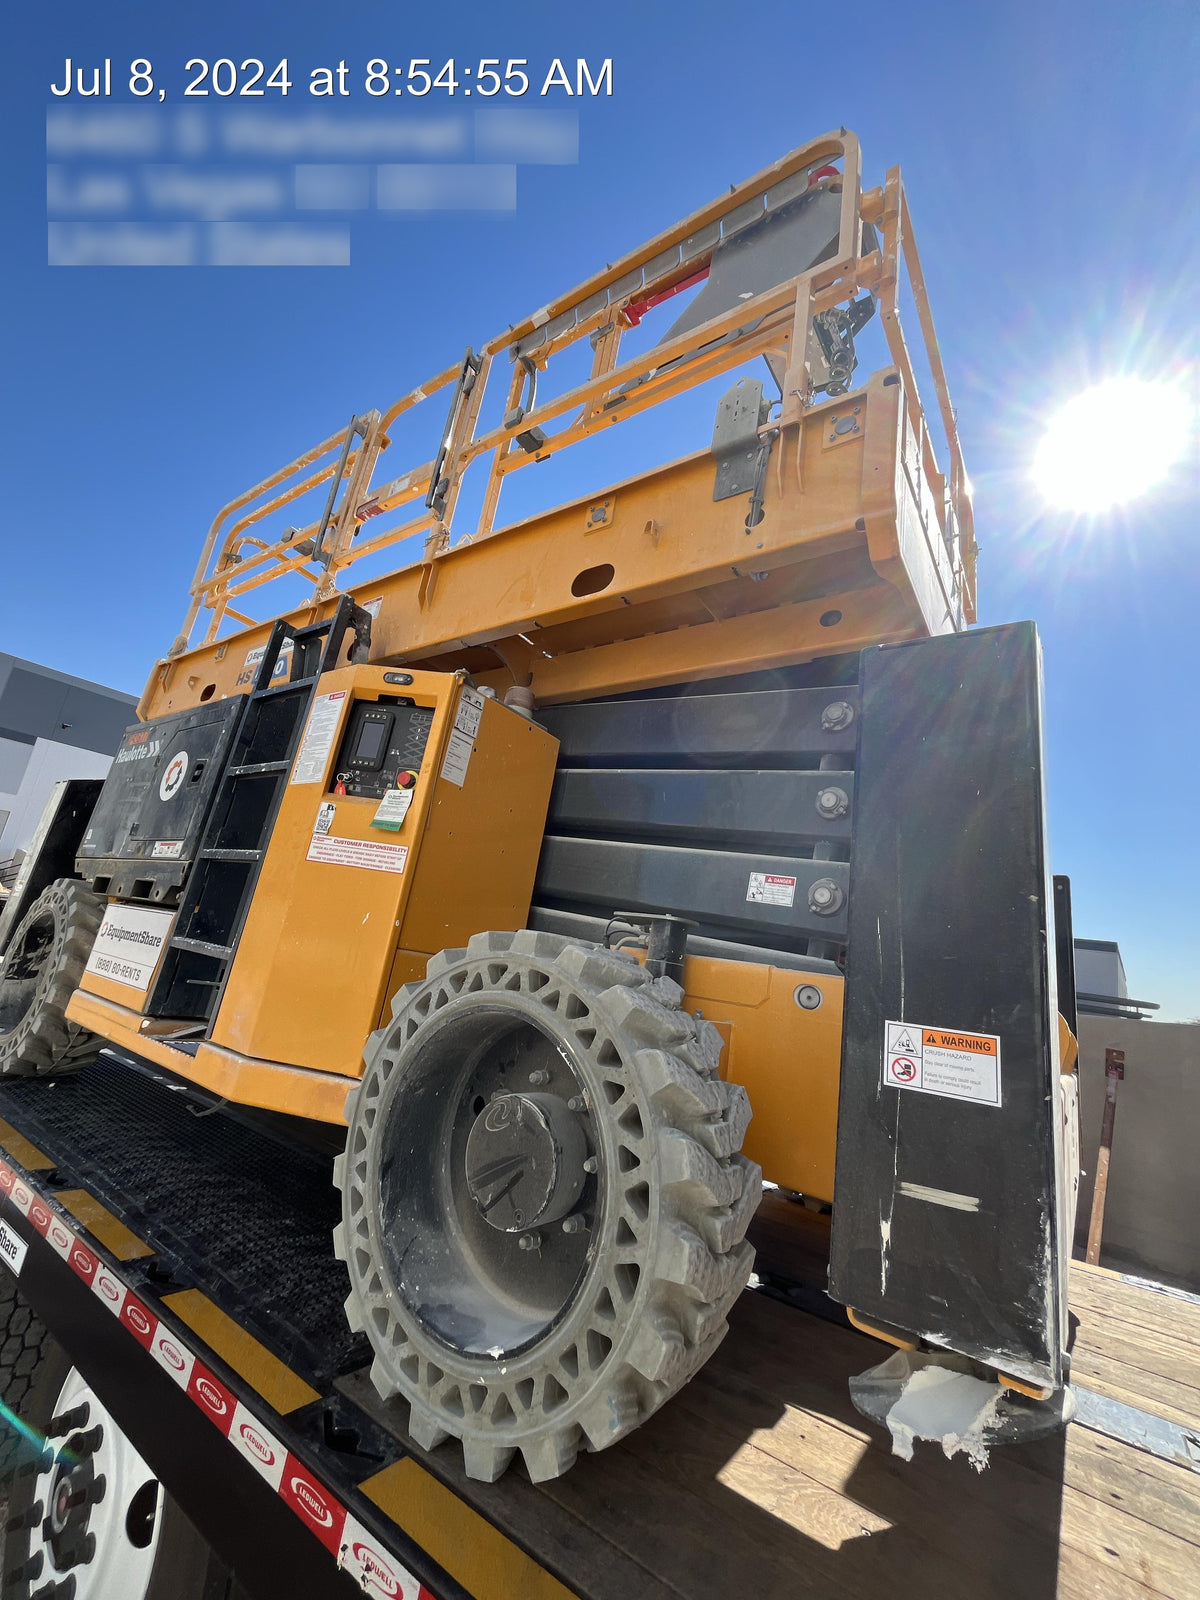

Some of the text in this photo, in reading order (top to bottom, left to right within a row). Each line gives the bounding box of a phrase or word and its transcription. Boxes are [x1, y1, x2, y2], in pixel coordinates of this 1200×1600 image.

[115, 744, 148, 764] Haulotte
[334, 838, 362, 848] CUSTOMER
[363, 842, 407, 853] RESPONSIBILITY
[107, 924, 162, 947] EquipmentShare
[924, 1049, 972, 1061] CRUSH HAZARD
[941, 1035, 991, 1052] WARNING
[202, 1384, 220, 1408] LEDWELL
[246, 1431, 268, 1459] LEDWELL
[299, 1485, 325, 1517] LEDWELL
[362, 1553, 392, 1590] LEDWELL
